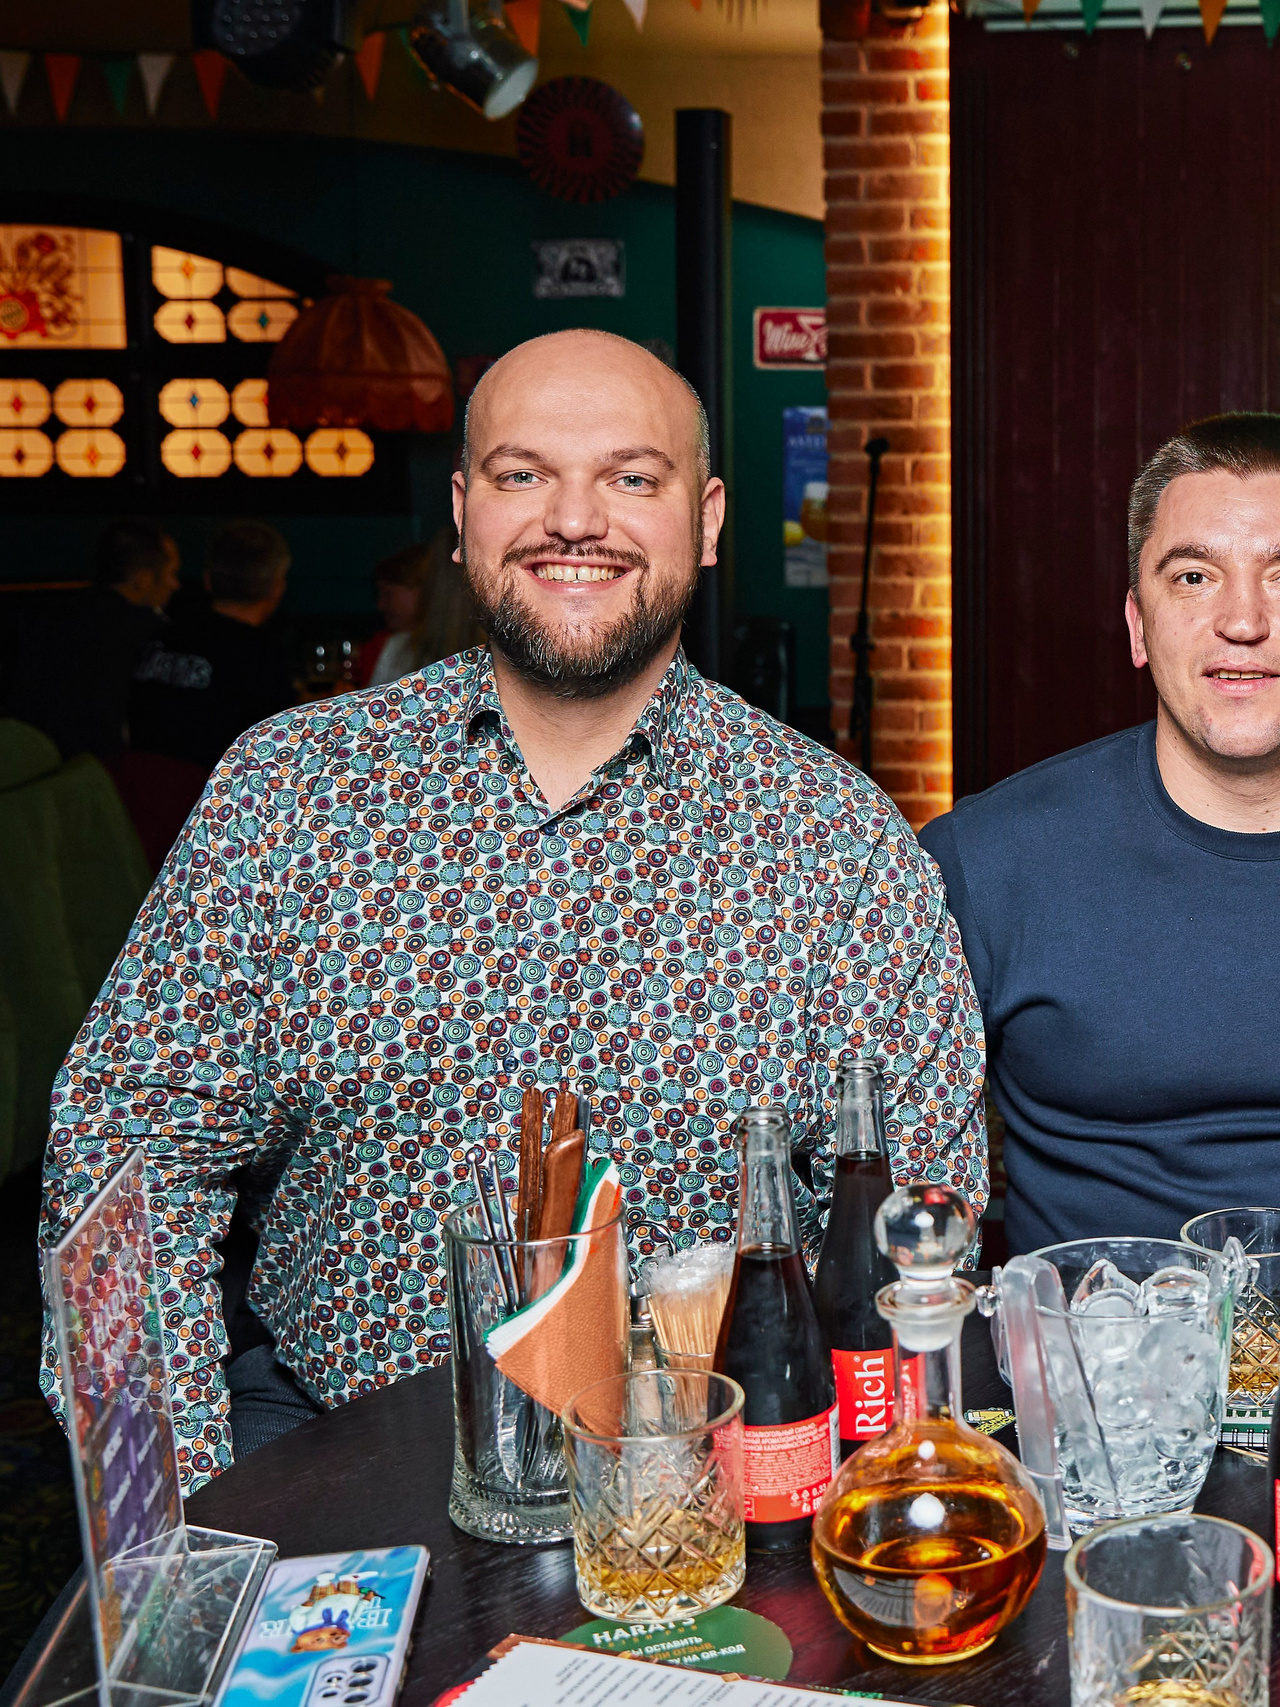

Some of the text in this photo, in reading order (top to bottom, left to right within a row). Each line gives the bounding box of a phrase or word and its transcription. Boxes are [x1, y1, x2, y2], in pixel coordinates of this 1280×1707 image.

[855, 1355, 887, 1435] Rich
[644, 1636, 703, 1656] ОСТАВИТЬ
[683, 1655, 701, 1665] НА
[701, 1643, 746, 1660] QR-КОД
